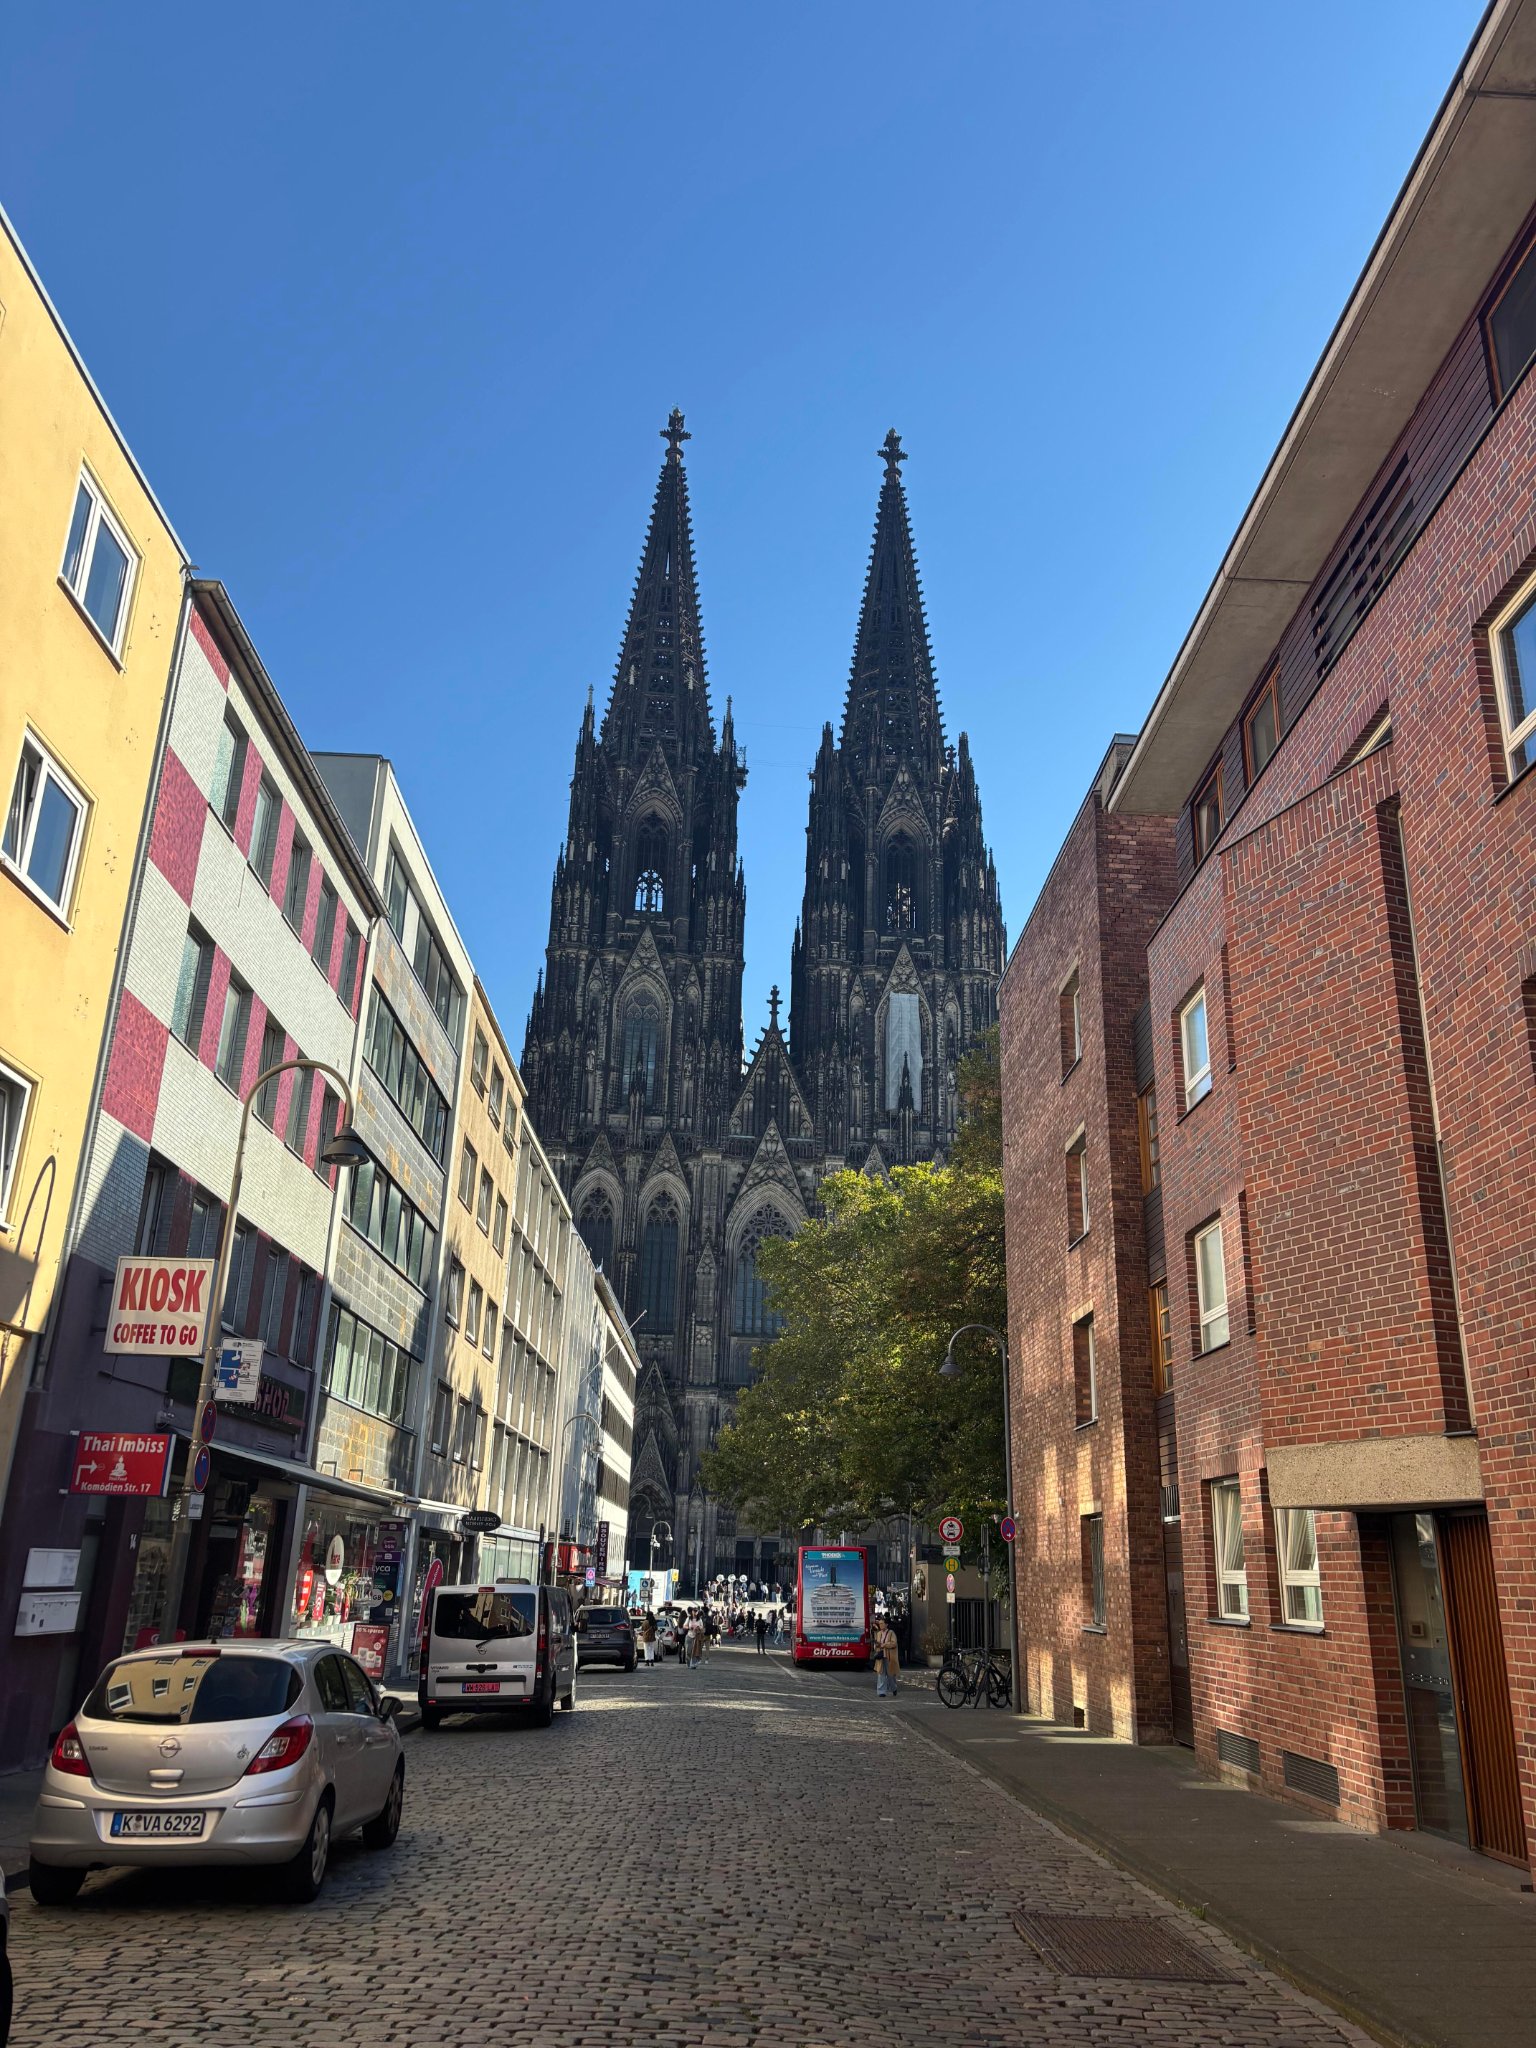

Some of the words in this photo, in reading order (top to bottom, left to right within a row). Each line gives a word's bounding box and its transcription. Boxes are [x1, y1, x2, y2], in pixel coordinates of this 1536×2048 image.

[119, 1267, 207, 1313] KIOSK
[113, 1322, 157, 1344] COFFEE
[159, 1324, 177, 1345] TO
[178, 1325, 198, 1346] GO
[83, 1436, 116, 1452] Thai
[117, 1437, 165, 1453] Imbiss
[124, 1483, 138, 1492] Str.
[140, 1484, 151, 1493] 17
[598, 1528, 607, 1572] SOUVENIRS
[122, 1815, 131, 1832] K
[143, 1815, 161, 1832] VA
[163, 1815, 201, 1832] 6292
